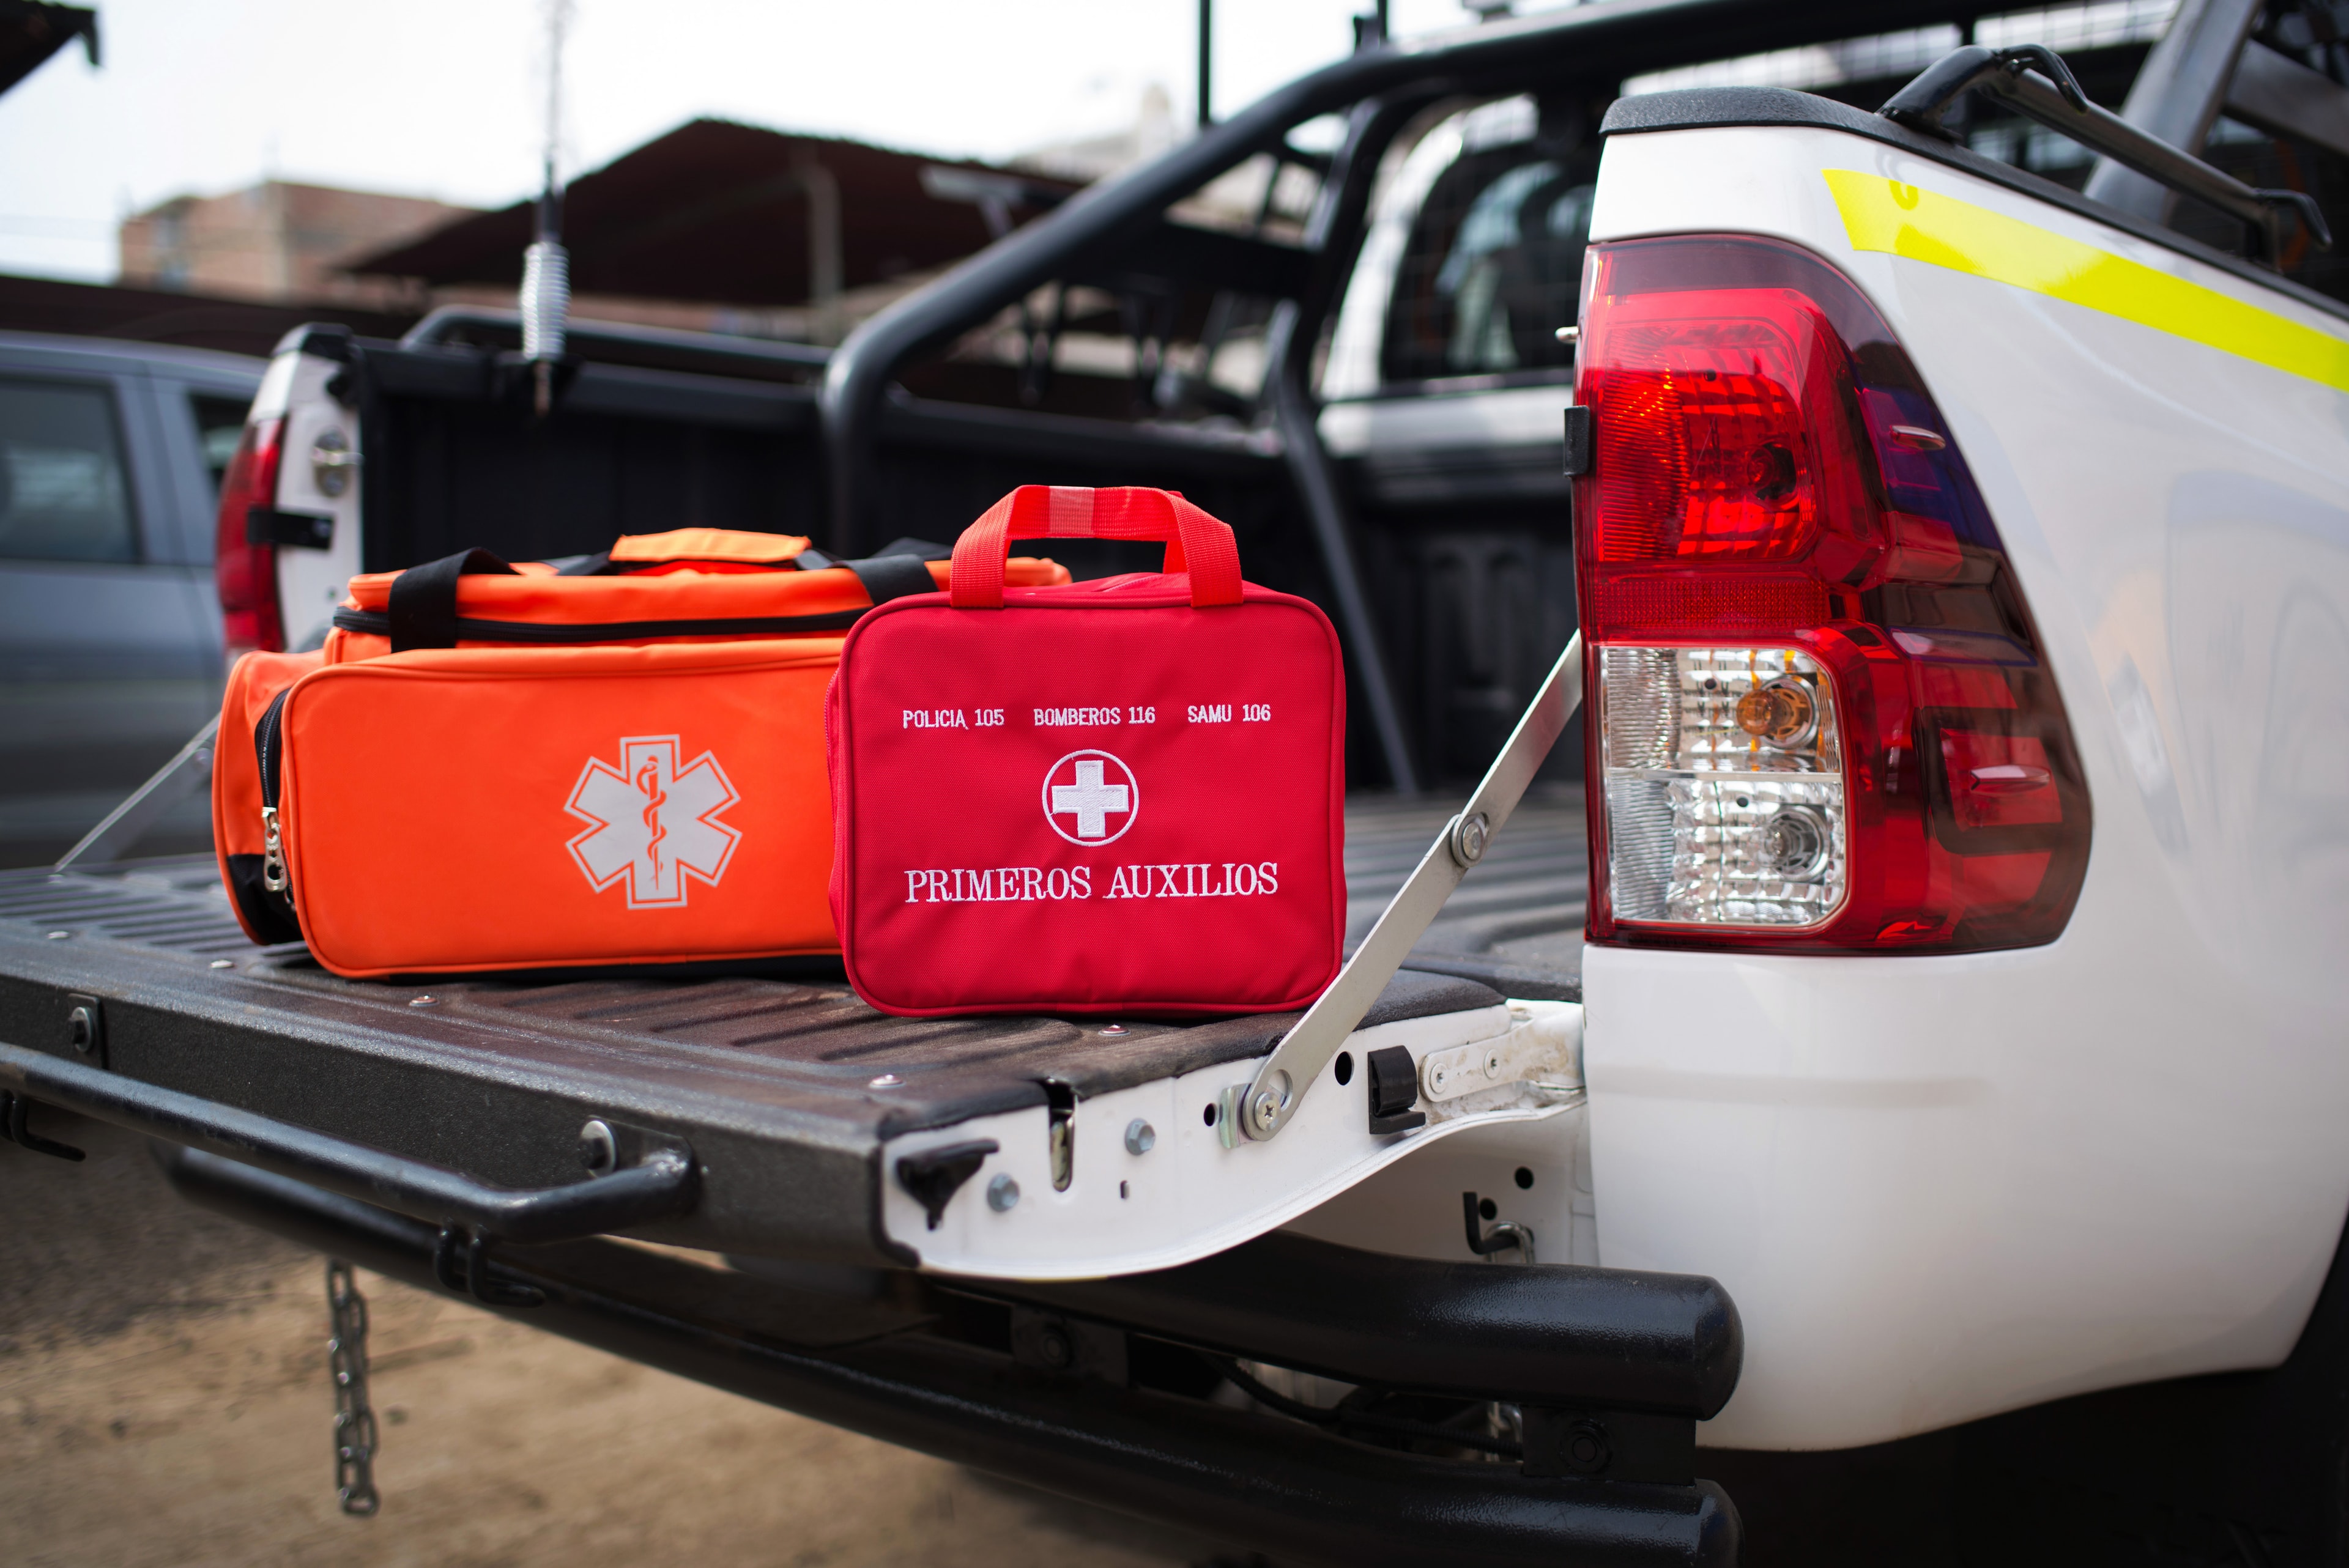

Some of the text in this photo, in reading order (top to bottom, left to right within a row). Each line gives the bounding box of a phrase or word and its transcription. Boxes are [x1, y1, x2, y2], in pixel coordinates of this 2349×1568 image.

[902, 704, 1271, 729] POLICIA 105 BOMBEROS 116 SAMU 106
[904, 862, 1278, 903] PRIMEROS AUXILIOS
